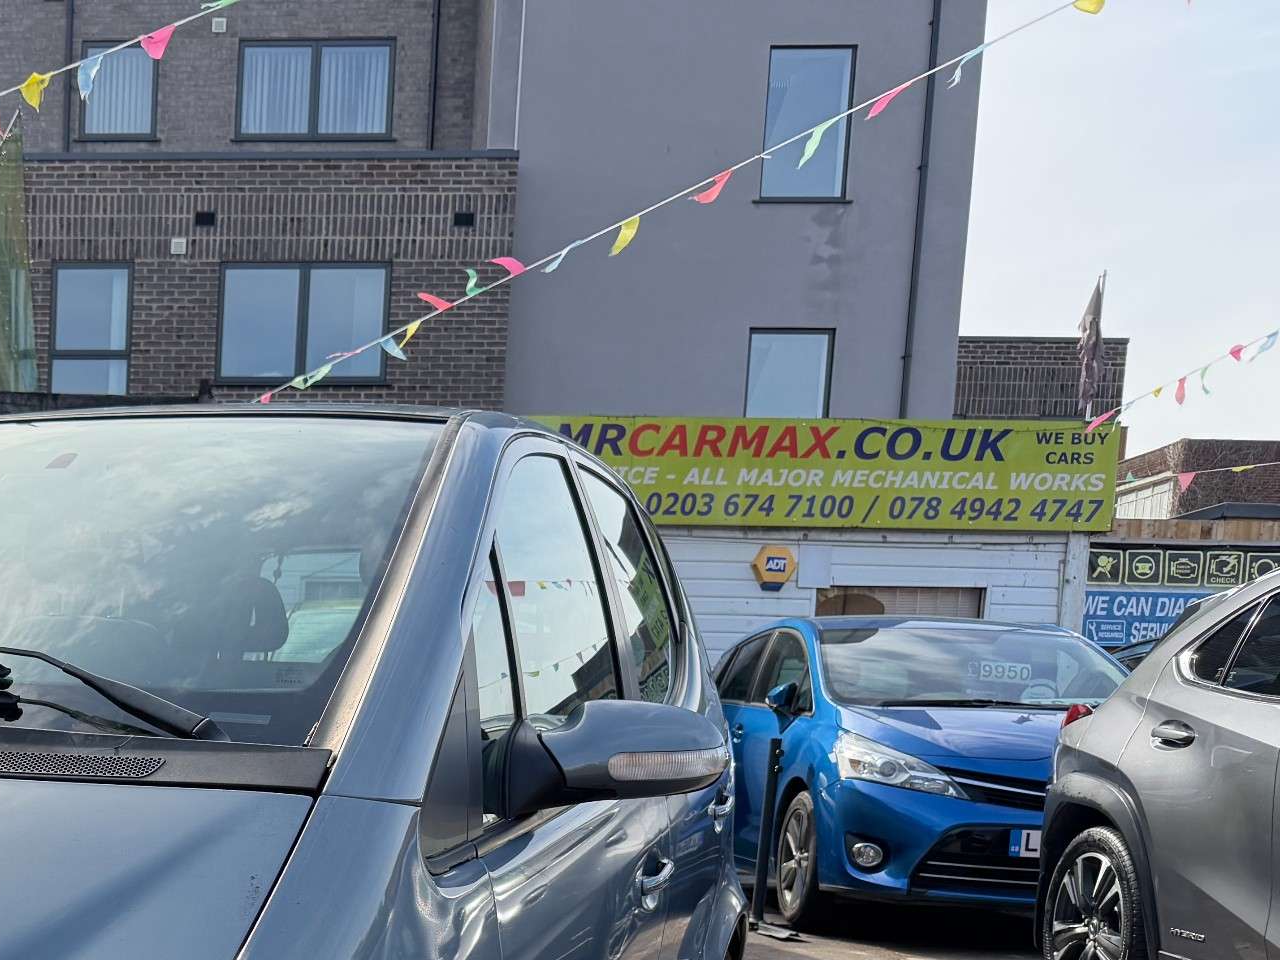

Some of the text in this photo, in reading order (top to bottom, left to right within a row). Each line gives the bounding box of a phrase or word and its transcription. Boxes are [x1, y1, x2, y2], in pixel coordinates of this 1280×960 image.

[558, 423, 1014, 462] MRCARMAX.CO.UK
[1036, 431, 1109, 446] WE BUY
[1045, 451, 1095, 465] CARS
[682, 466, 729, 486] ALL
[736, 467, 822, 488] MAJOR
[831, 469, 999, 491] MECHANICAL
[1008, 472, 1107, 493] WORKS
[646, 491, 716, 517] 0203
[723, 493, 775, 518] 674
[784, 494, 855, 520] 7100
[888, 496, 943, 521] 078
[950, 497, 1022, 523] 4942
[1030, 498, 1105, 523] 4747
[765, 559, 787, 571] ADT
[1084, 594, 1198, 617] WE CAN DIA
[1129, 621, 1175, 643] SERV
